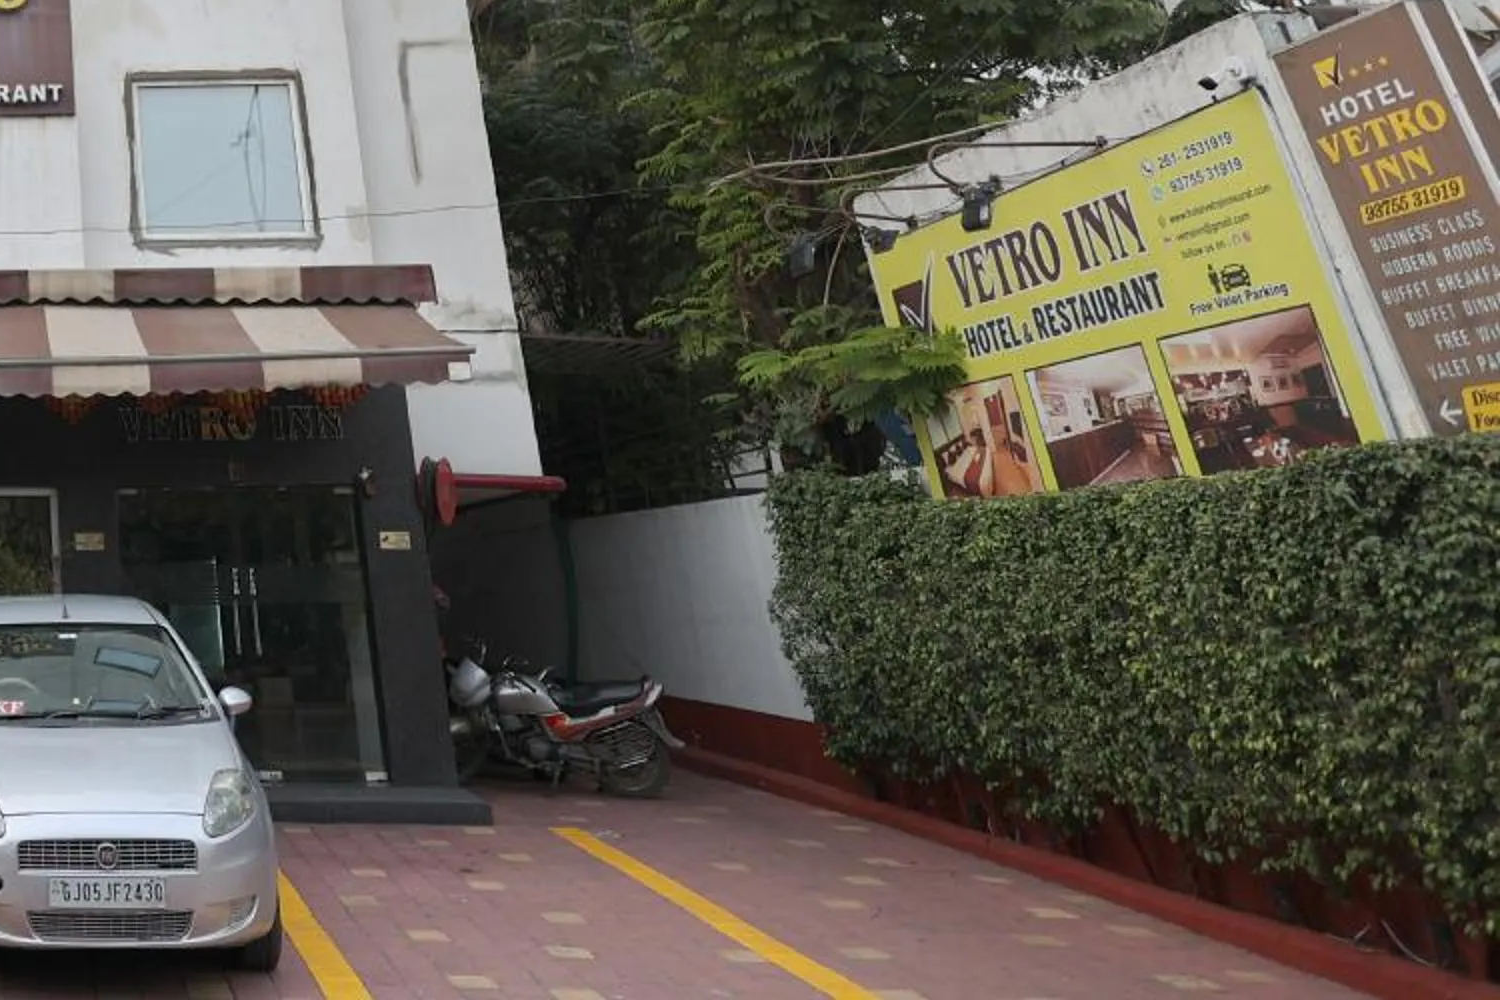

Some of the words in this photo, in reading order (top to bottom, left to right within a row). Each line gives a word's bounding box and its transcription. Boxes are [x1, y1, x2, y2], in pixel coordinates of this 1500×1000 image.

[1319, 77, 1415, 127] HOTEL
[1316, 99, 1447, 165] VETRO
[1360, 145, 1435, 193] INN
[1365, 198, 1409, 221] 93755
[1411, 180, 1460, 206] 31919
[946, 221, 1061, 308] VETRO
[1061, 189, 1147, 271] INN
[1370, 222, 1433, 253] BUSINESS
[1437, 208, 1485, 236] CLASS
[1381, 251, 1438, 278] MODERN
[1442, 236, 1496, 262] ROOMS
[1190, 302, 1213, 316] Free
[1214, 293, 1242, 309] Valet
[1246, 283, 1289, 299] Parking
[1381, 279, 1431, 306] BUFFET
[964, 315, 1022, 357] HOTEL
[1023, 322, 1033, 343] &
[1032, 272, 1164, 340] RESTAURANT
[1404, 302, 1457, 330] BUFFET
[1434, 328, 1470, 351] FREE
[1426, 357, 1470, 383] VALET
[118, 406, 258, 441] VETRO
[270, 405, 344, 441] INN
